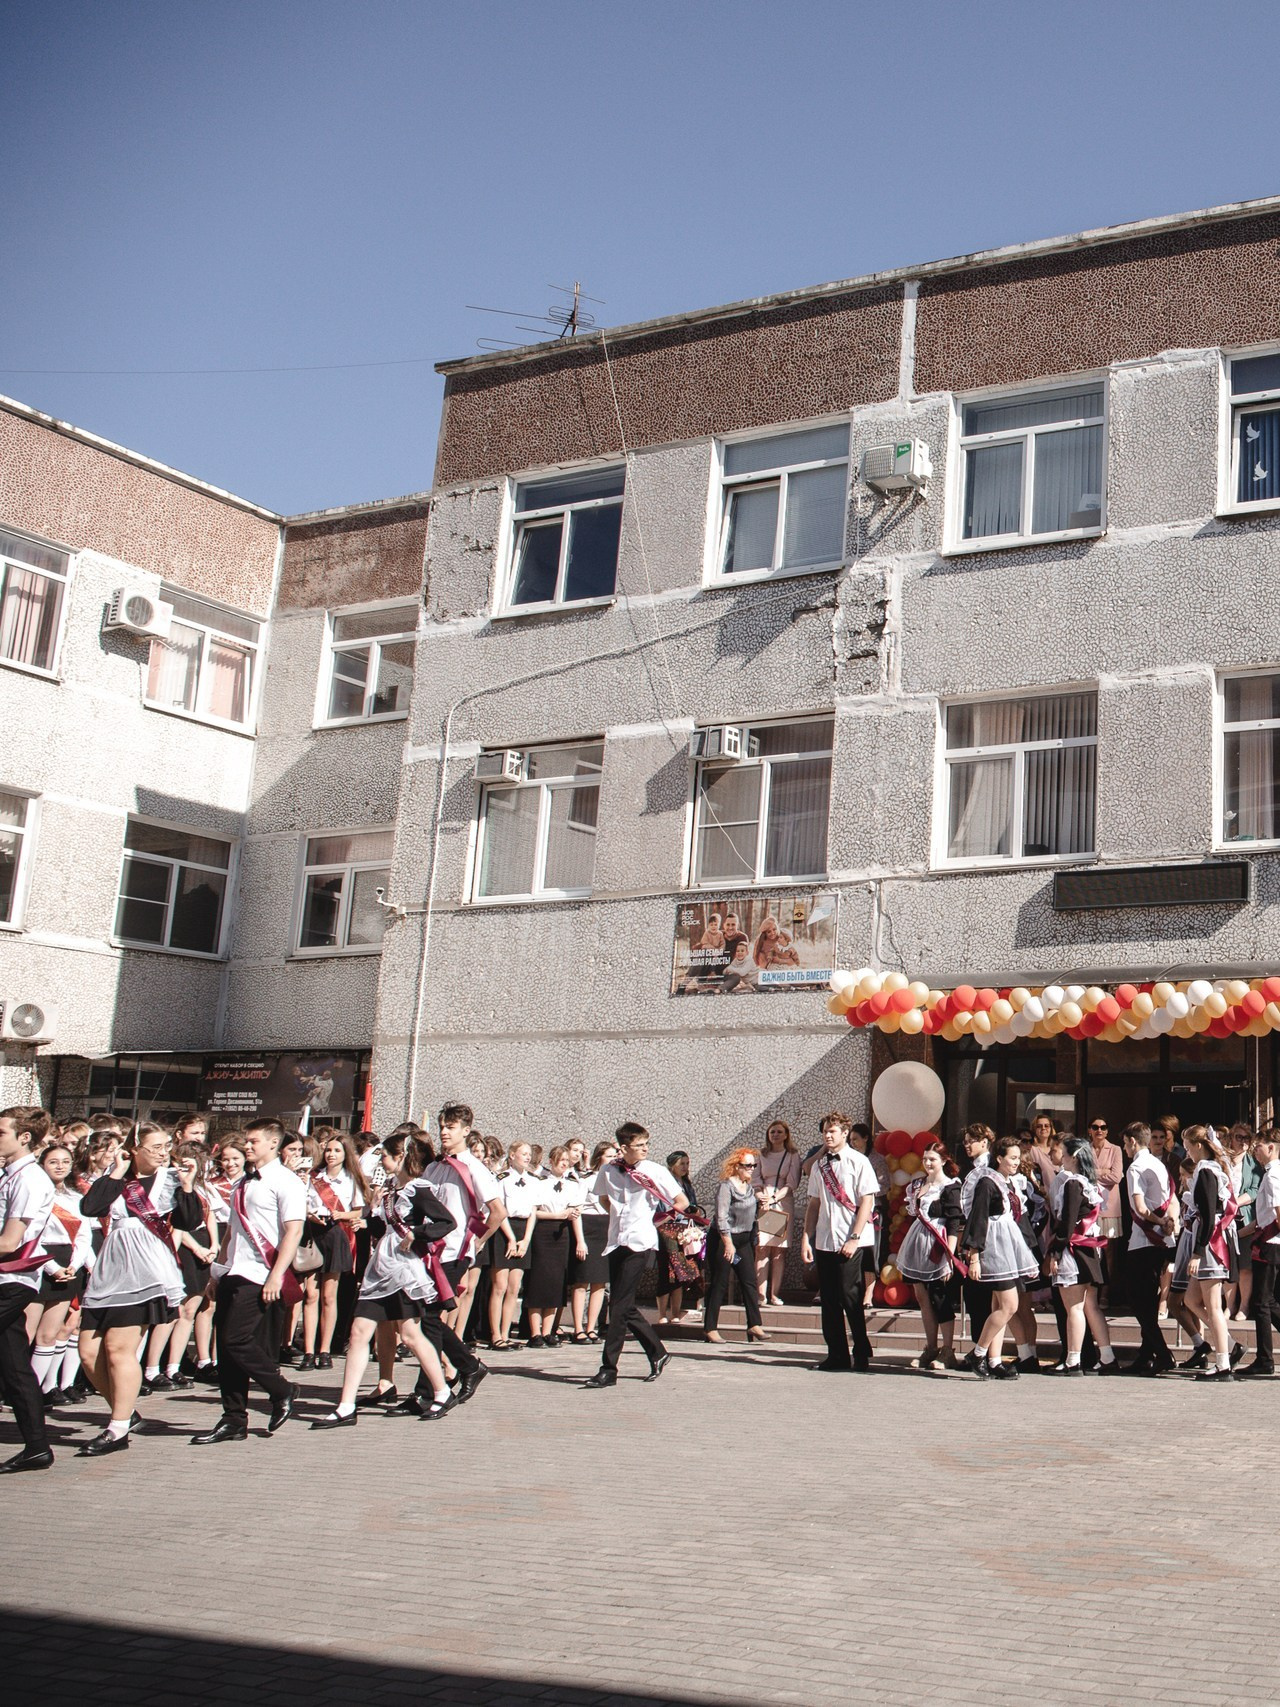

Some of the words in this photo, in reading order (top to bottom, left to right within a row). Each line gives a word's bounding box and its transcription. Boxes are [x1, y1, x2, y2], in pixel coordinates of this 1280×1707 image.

[706, 948, 724, 956] СЕМЬЯ
[762, 972, 786, 982] ВАЖНО
[786, 971, 804, 981] БЫТЬ
[806, 970, 832, 980] ВМЕСТЕ
